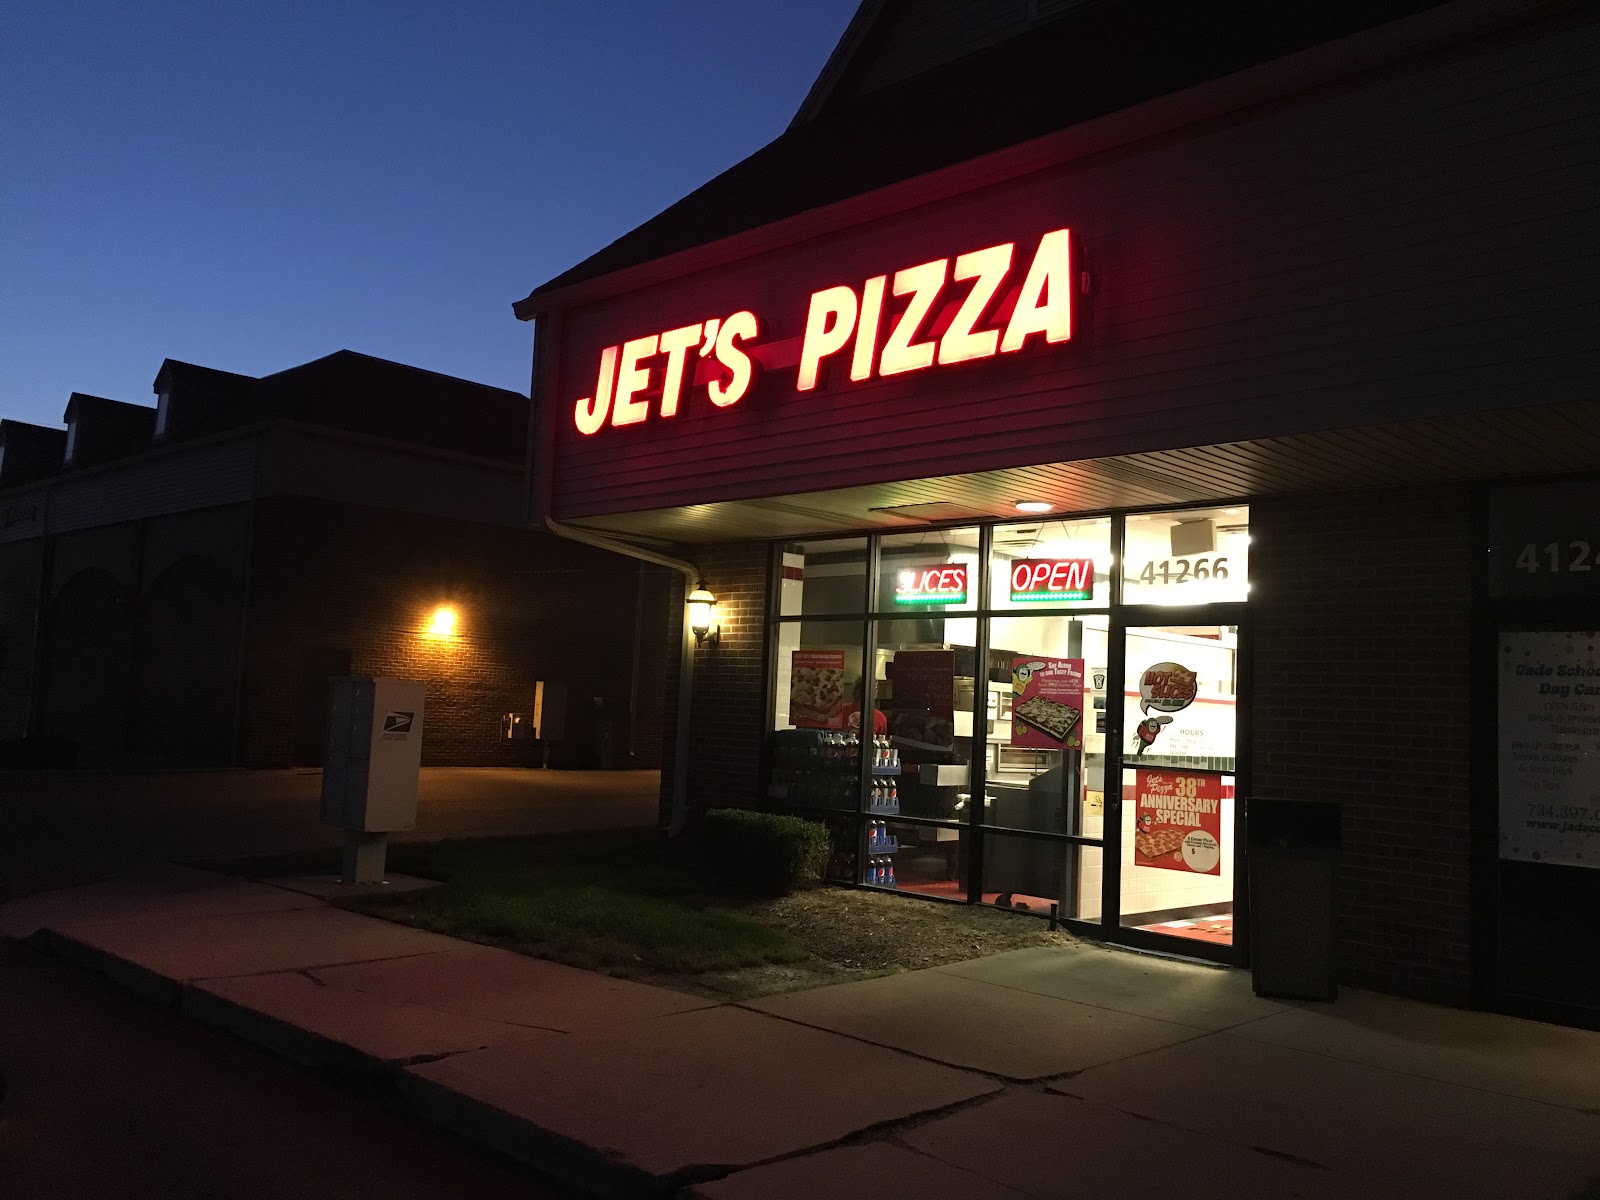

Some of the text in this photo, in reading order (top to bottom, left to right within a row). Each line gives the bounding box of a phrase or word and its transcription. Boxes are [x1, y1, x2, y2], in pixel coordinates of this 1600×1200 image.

[574, 228, 1072, 436] JET'S PIZZA
[1515, 541, 1600, 573] 412
[1011, 561, 1089, 592] OPEN
[1140, 558, 1229, 585] 41266
[896, 570, 965, 593] SLICES
[1144, 671, 1174, 686] HOT
[1516, 663, 1554, 677] Jade
[1151, 684, 1194, 701] SLICES
[1539, 683, 1570, 699] Day
[1146, 774, 1164, 788] Jet's
[1149, 783, 1174, 796] Pizza
[1140, 793, 1218, 815] ANNIVERSARY
[1156, 809, 1202, 828] SPECIAL
